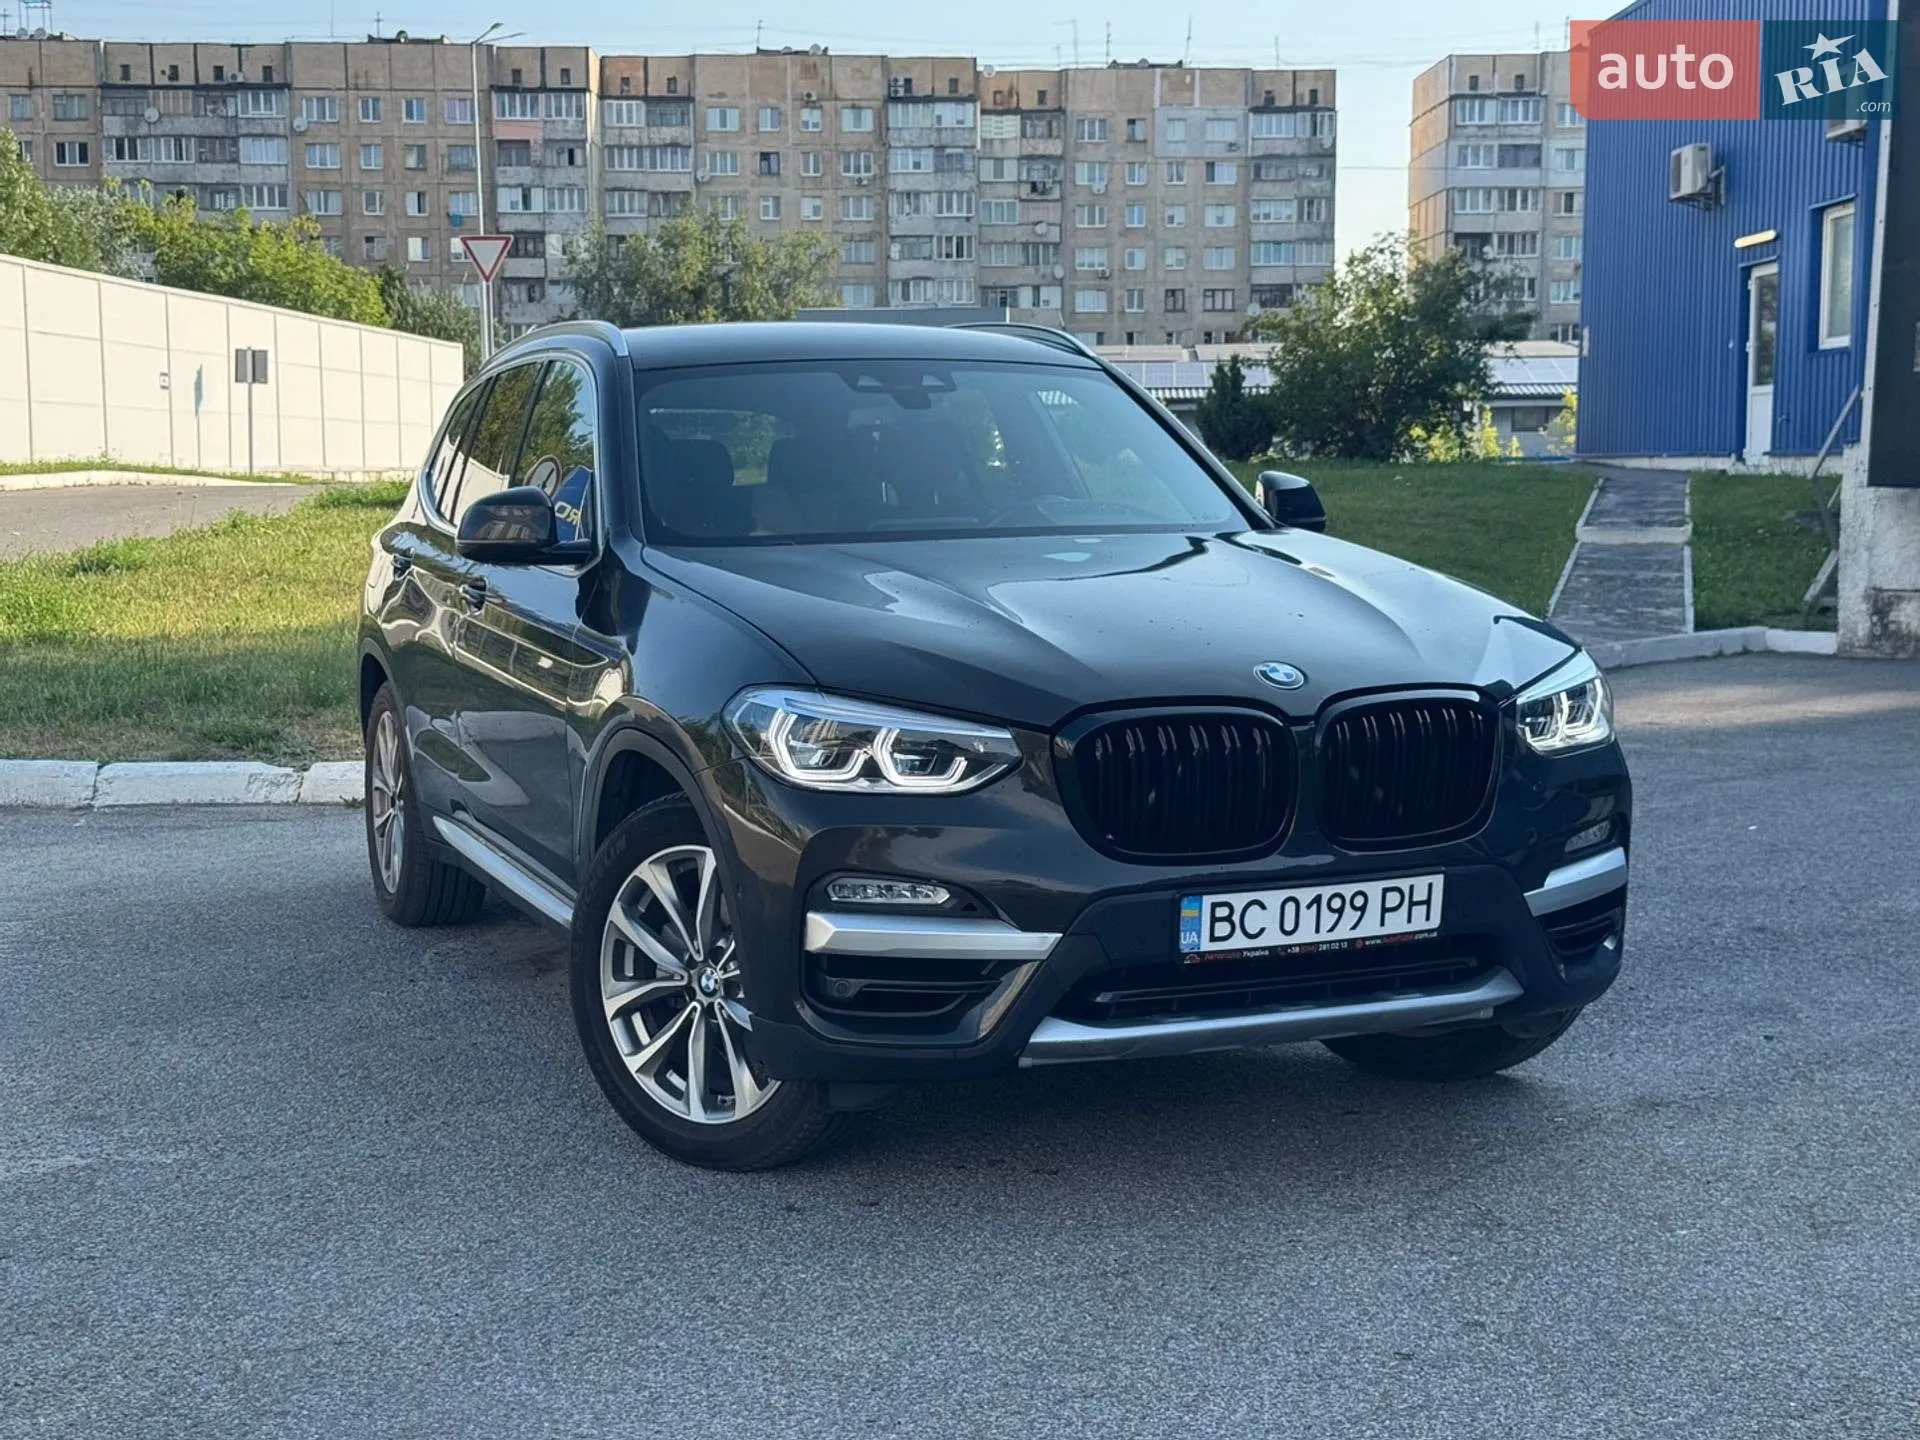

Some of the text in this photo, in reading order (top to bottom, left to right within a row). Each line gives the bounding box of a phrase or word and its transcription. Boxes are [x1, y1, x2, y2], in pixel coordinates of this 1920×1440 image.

[1209, 881, 1433, 943] BC 0199 PH
[1180, 931, 1198, 945] UA
